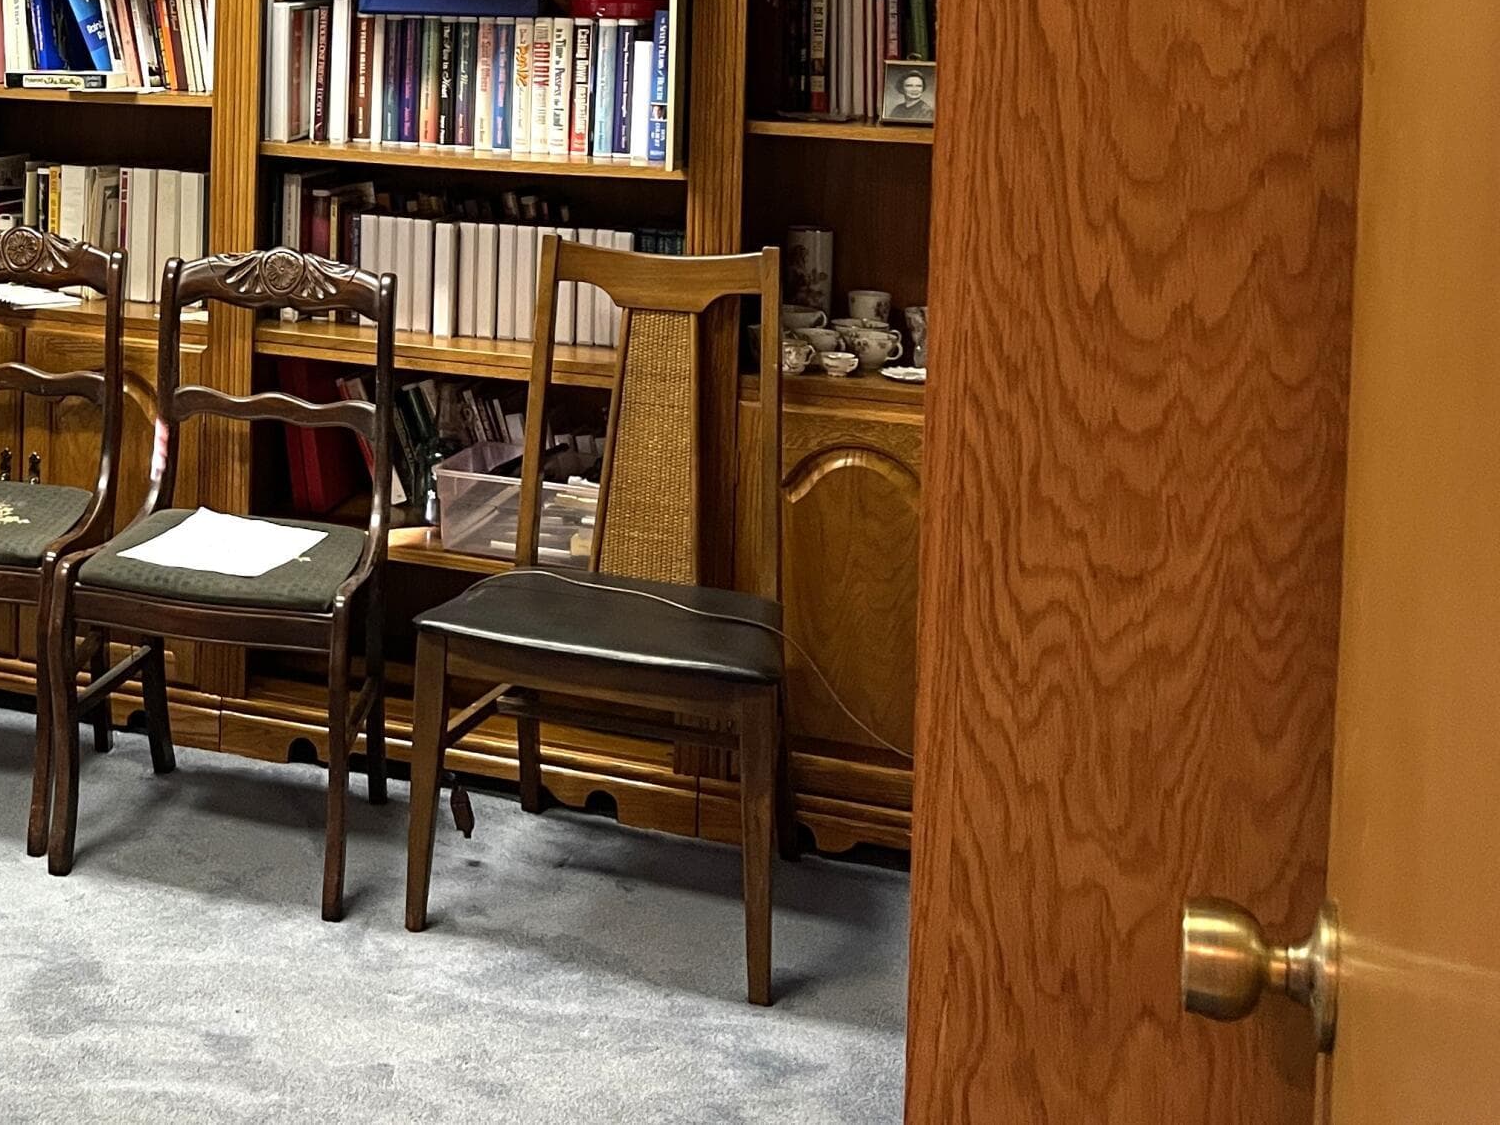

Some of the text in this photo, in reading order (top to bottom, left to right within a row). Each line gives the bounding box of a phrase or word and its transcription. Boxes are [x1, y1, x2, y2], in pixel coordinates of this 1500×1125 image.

[659, 25, 667, 44] SEVEN
[813, 19, 822, 37] THAT
[555, 39, 566, 59] Time
[658, 45, 666, 69] PILLARS
[533, 42, 550, 86] BOLDLY
[553, 68, 566, 96] Possess
[574, 29, 589, 134] Casting Down Imaginations
[656, 76, 664, 101] HEALTH
